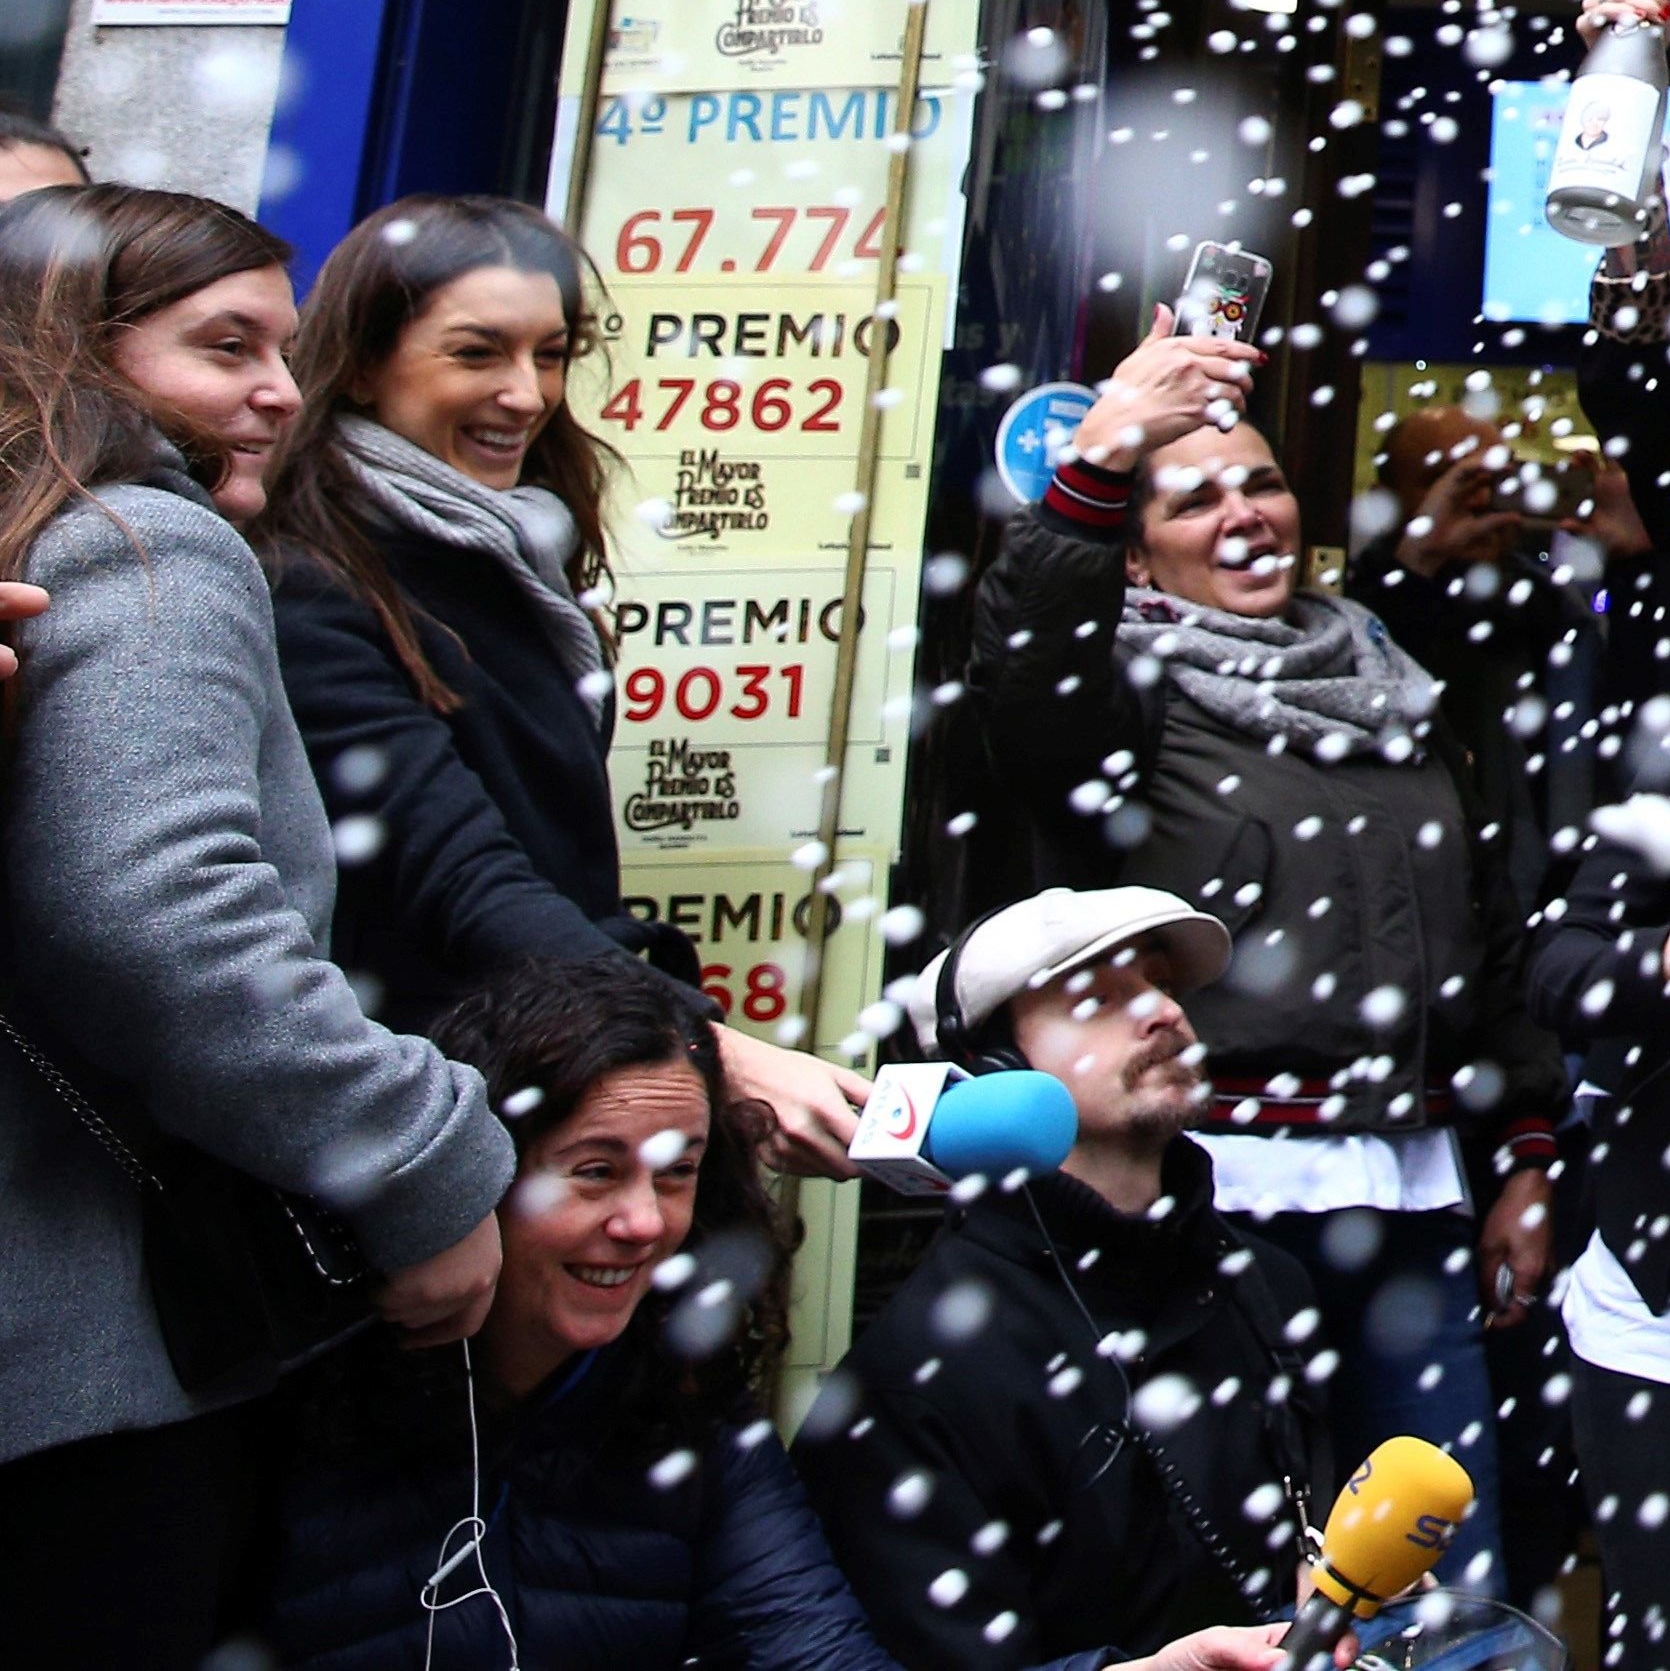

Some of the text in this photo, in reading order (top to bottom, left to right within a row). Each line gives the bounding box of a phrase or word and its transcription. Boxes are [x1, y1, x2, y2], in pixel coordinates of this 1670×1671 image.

[600, 99, 668, 146] 4º
[646, 313, 901, 359] PREMIO
[600, 378, 843, 433] 47862
[615, 597, 866, 647] PREMIO
[624, 792, 740, 831] COMPARTIRLO
